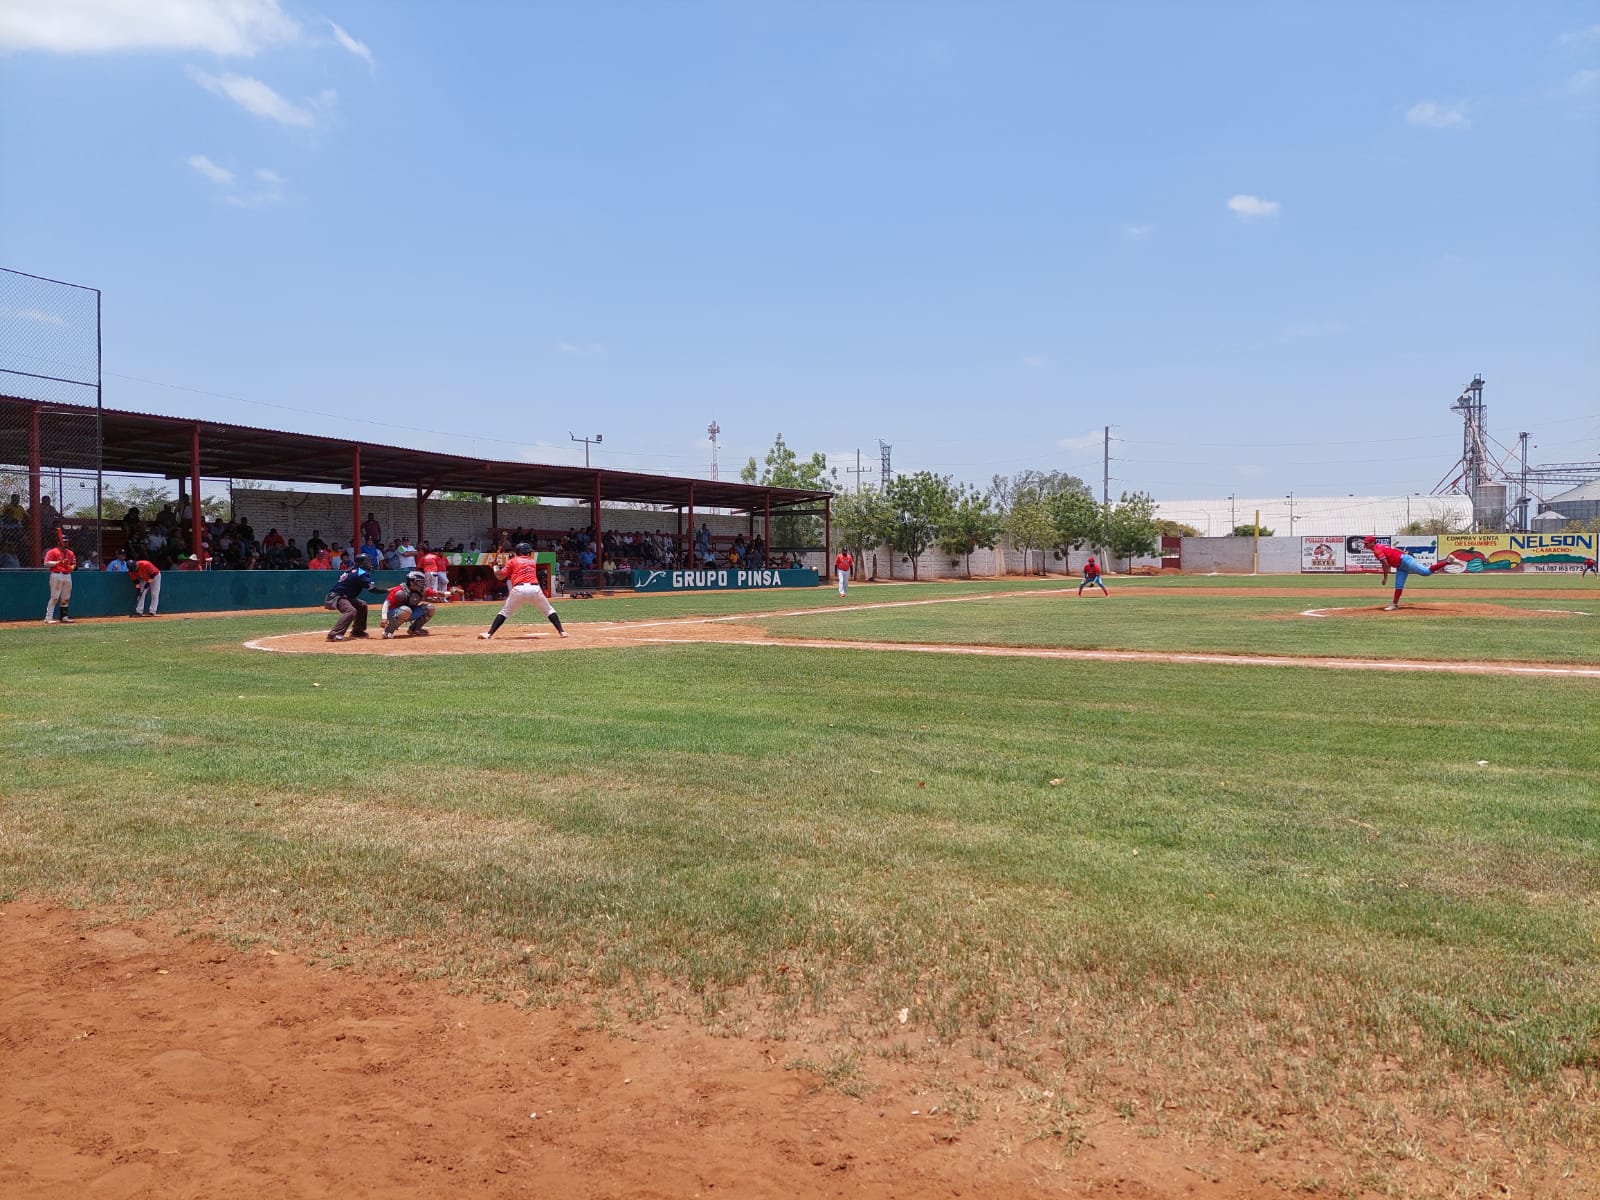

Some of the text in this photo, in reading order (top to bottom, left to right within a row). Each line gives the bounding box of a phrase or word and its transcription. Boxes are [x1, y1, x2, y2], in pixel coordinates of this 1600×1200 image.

[1509, 534, 1593, 550] NELSON
[672, 570, 782, 588] GRUPO PINSA
